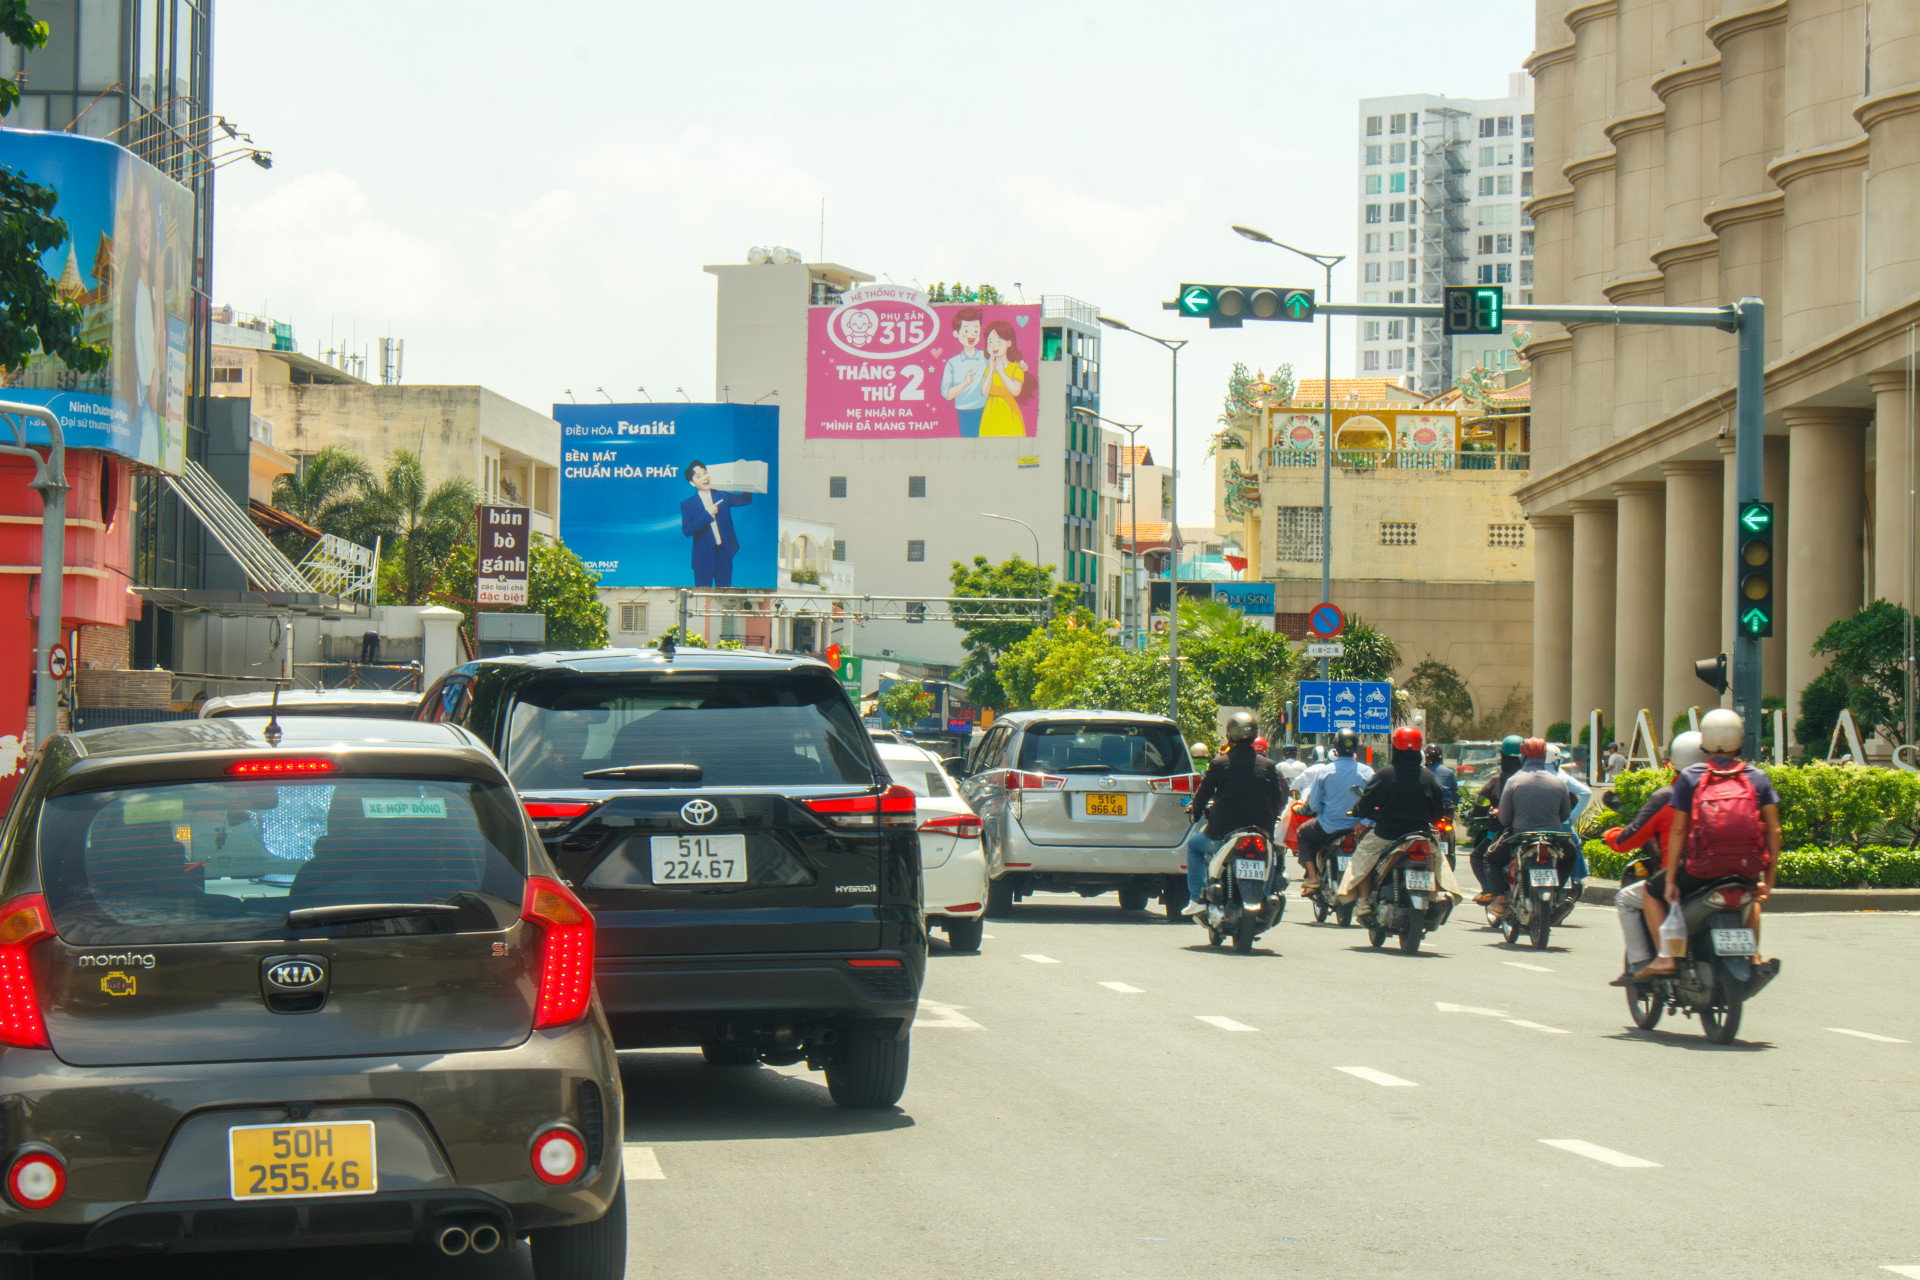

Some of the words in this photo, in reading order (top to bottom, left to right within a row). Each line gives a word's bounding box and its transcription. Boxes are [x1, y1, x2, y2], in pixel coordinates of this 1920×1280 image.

[851, 292, 862, 302] HỆ
[864, 287, 896, 298] THỐNG
[898, 290, 905, 298] Y
[906, 287, 918, 301] TẾ
[880, 312, 901, 321] PHỤ
[904, 310, 924, 320] SẢN
[1477, 291, 1497, 328] 7
[879, 320, 925, 344] 315
[836, 361, 896, 380] THÁNG
[861, 382, 897, 401] THỨ
[899, 364, 925, 401] 2
[69, 400, 91, 414] Ninh
[846, 408, 862, 420] MẸ
[864, 406, 895, 420] NHẬN
[898, 408, 913, 417] RA
[61, 415, 76, 429] Đại
[77, 417, 88, 428] sứ
[565, 423, 589, 436] ĐIỀU
[591, 424, 614, 436] HÒA
[617, 420, 676, 435] Funiki
[855, 420, 871, 431] ĐÃ
[874, 421, 906, 431] MANG
[565, 448, 589, 462] BỀN
[592, 449, 618, 462] MÁT
[564, 462, 611, 479] CHUẨN
[614, 464, 643, 478] HÒA
[646, 463, 679, 478] PHÁT
[489, 508, 523, 526] bún
[493, 532, 516, 549] bò
[481, 555, 525, 574] gánh
[497, 574, 507, 582] &
[481, 583, 494, 591] các
[511, 583, 524, 591] chè
[480, 592, 500, 602] đặc
[503, 592, 525, 602] biệt
[1230, 594, 1246, 605] NU
[1247, 594, 1269, 605] SKIN
[1098, 795, 1116, 804] 51G
[368, 803, 384, 813] XE
[386, 801, 409, 815] HỢP
[411, 801, 442, 814] ĐỒNG
[1091, 804, 1123, 814] 966.48
[679, 838, 718, 858] 51L
[663, 860, 735, 880] 224.67
[78, 951, 156, 969] morning
[277, 966, 316, 983] KIA
[272, 1128, 334, 1159] 50H
[248, 1160, 360, 1194] 255.46
